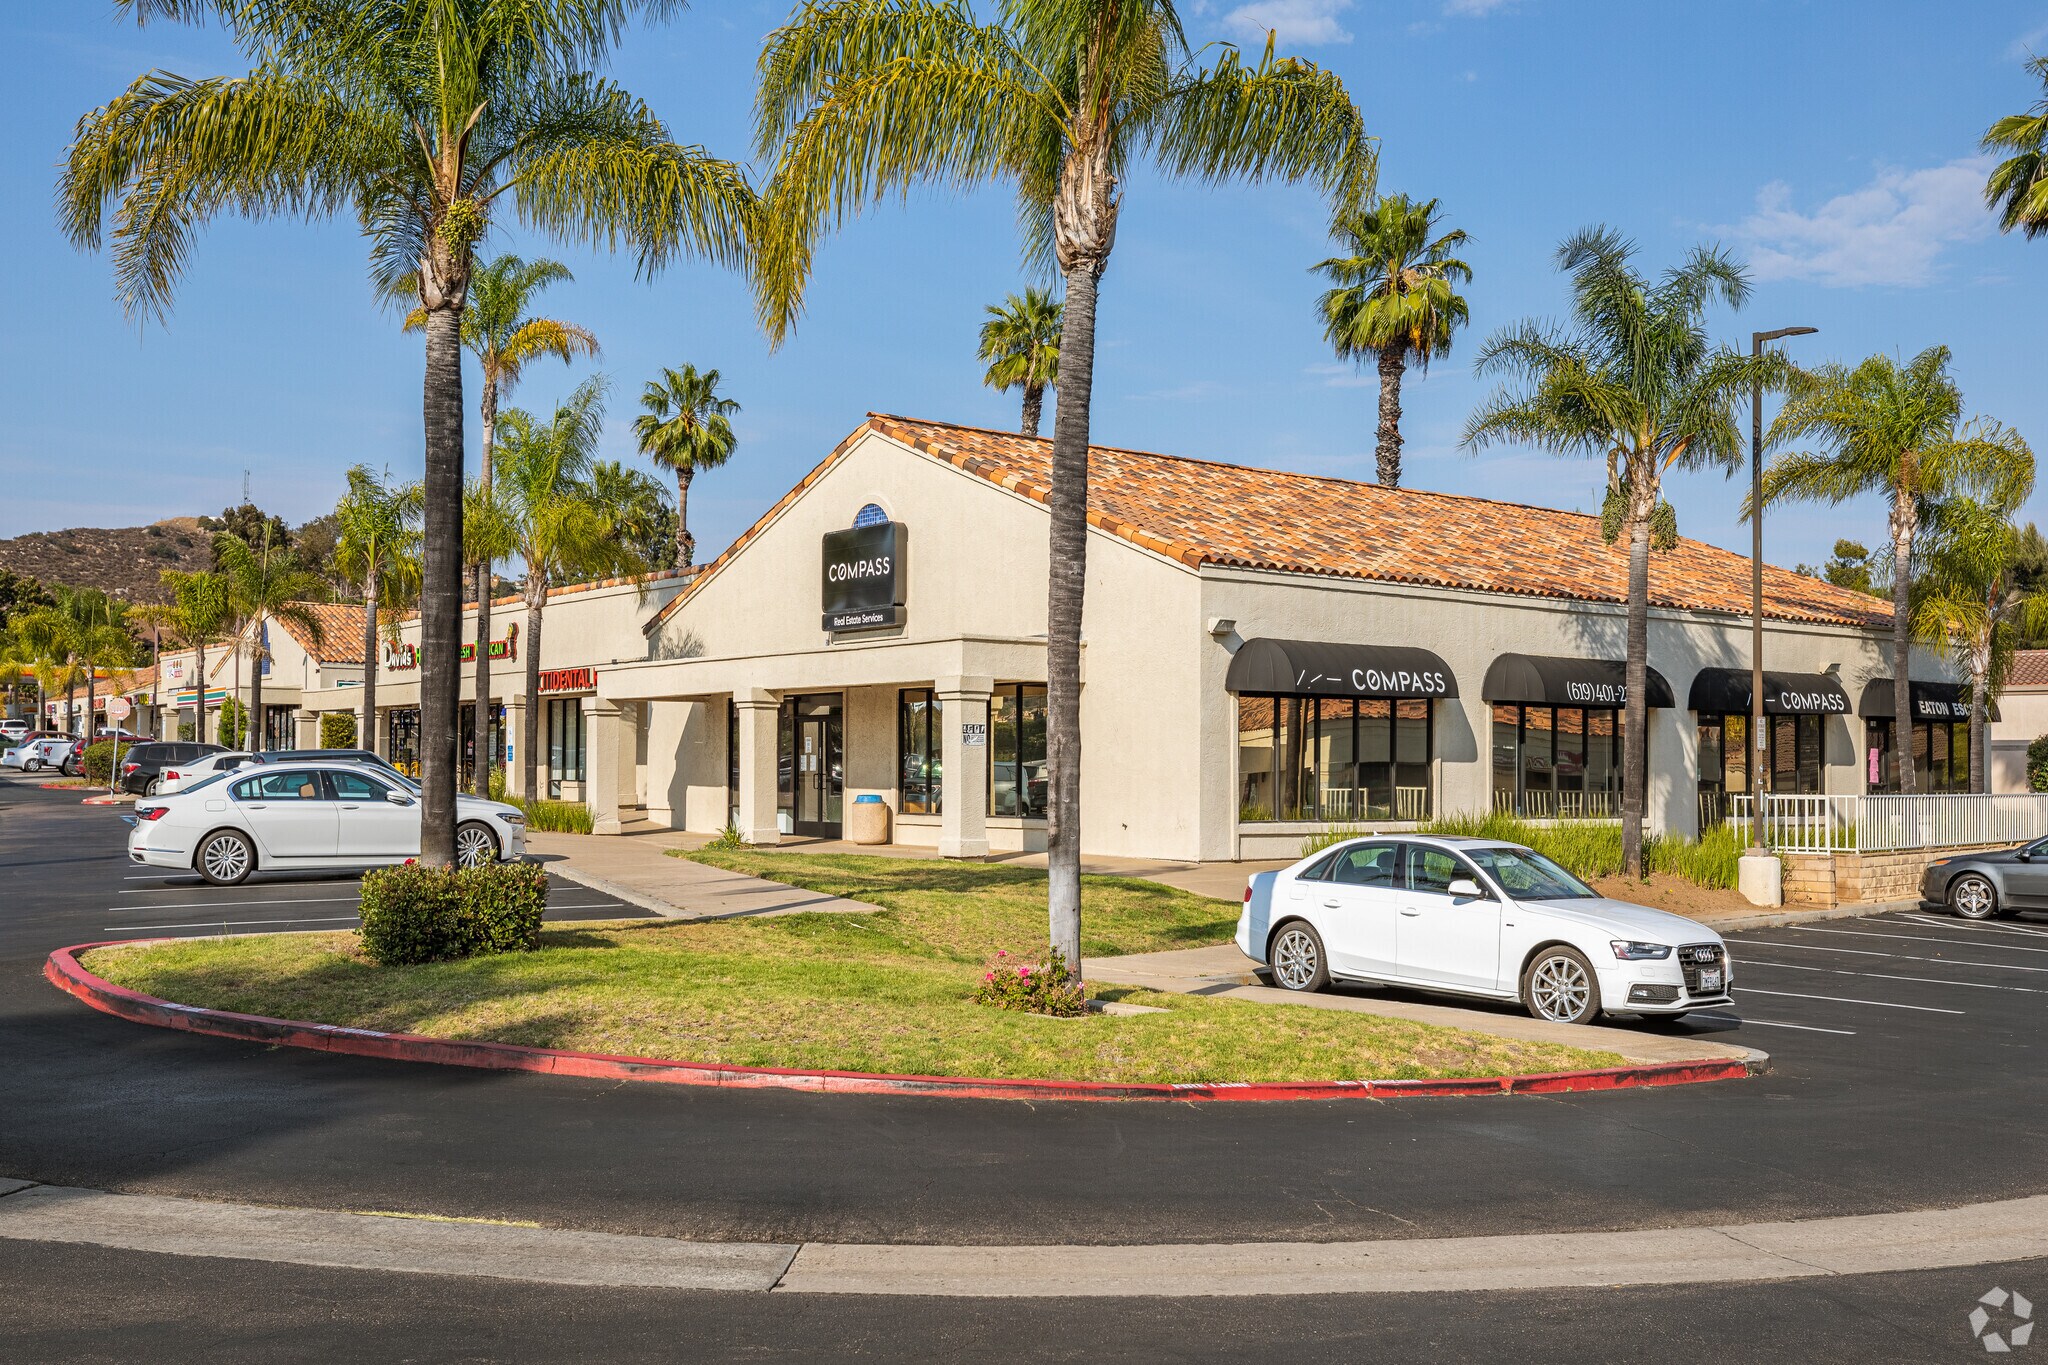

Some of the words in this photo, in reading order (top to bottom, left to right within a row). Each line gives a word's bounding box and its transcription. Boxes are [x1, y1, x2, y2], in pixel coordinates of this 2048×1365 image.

[828, 556, 891, 582] COMPASS
[833, 616, 846, 626] Real
[846, 615, 861, 626] Estate
[862, 613, 884, 624] Services
[1352, 668, 1446, 693] COMPASS
[1596, 684, 1627, 702] 401-2
[1781, 691, 1845, 711] COMPASS
[1917, 700, 1950, 716] EATON
